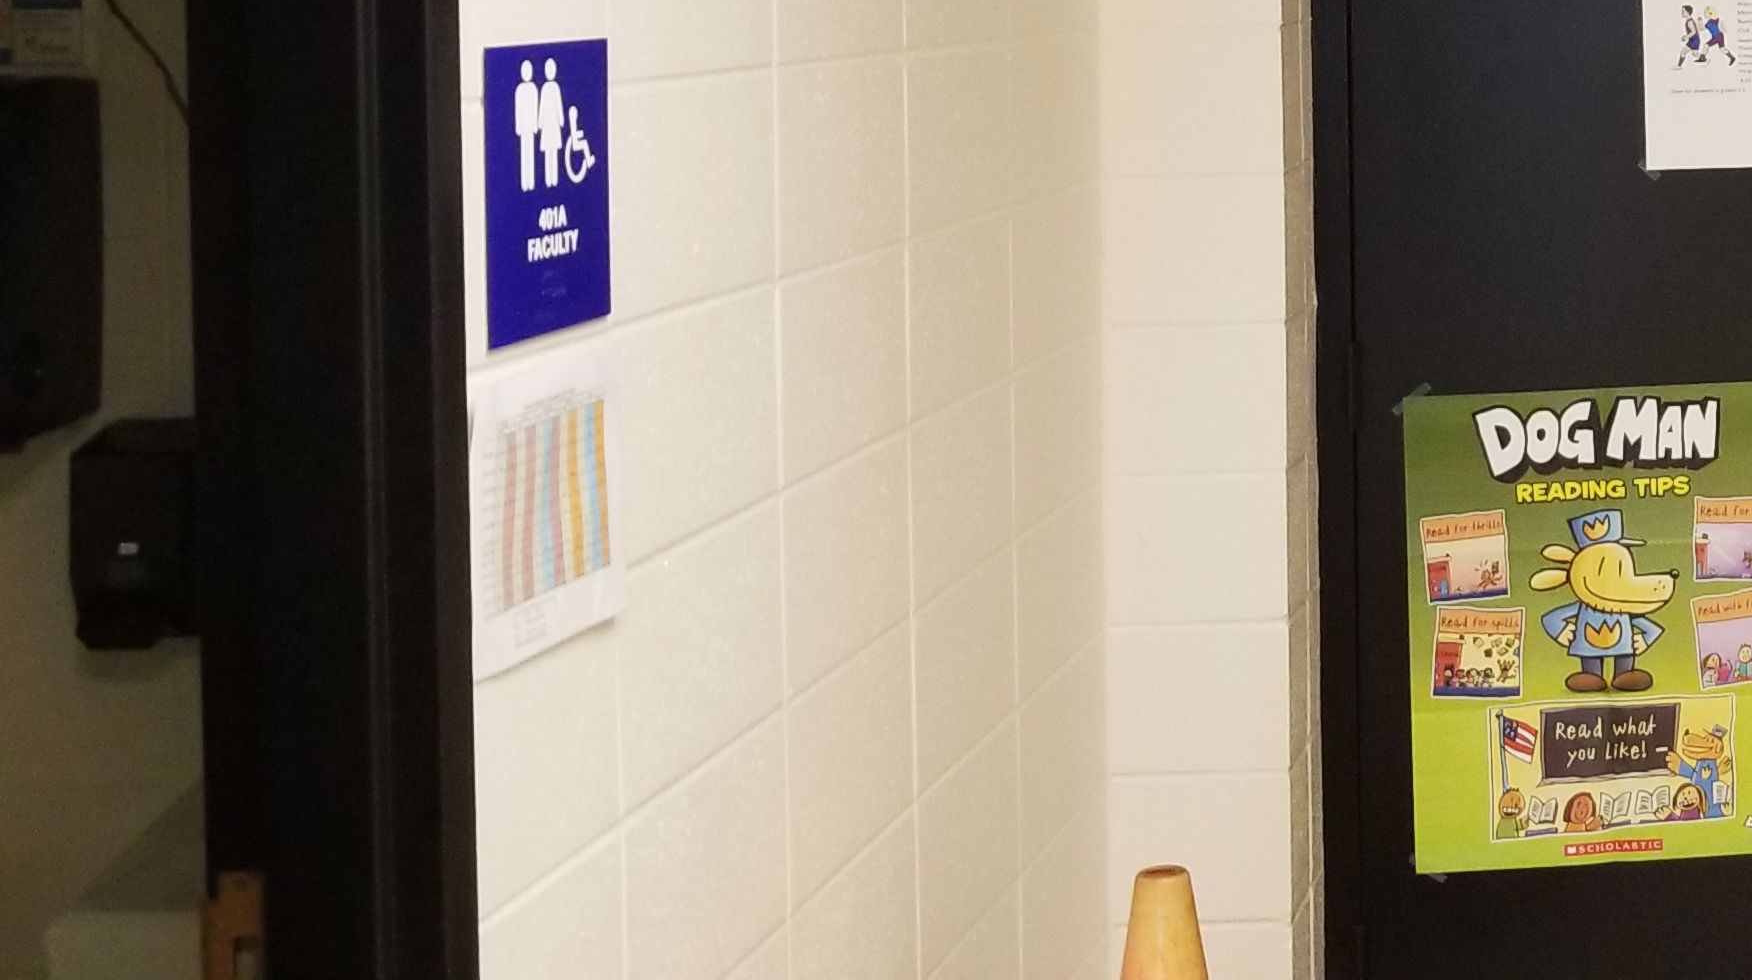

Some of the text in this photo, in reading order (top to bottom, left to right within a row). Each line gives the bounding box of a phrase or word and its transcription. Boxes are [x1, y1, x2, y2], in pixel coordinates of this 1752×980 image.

[538, 203, 568, 232] 401A
[527, 228, 580, 263] FACULTY
[1473, 397, 1719, 479] DOG MAN
[1515, 475, 1692, 504] READING TIPS
[1699, 504, 1728, 517] Read
[1733, 505, 1750, 516] for
[1440, 616, 1468, 628] Read
[1472, 616, 1488, 627] for
[1554, 713, 1657, 741] Read what
[1566, 746, 1596, 769] you
[1577, 839, 1663, 854] SCHOLASTIC
